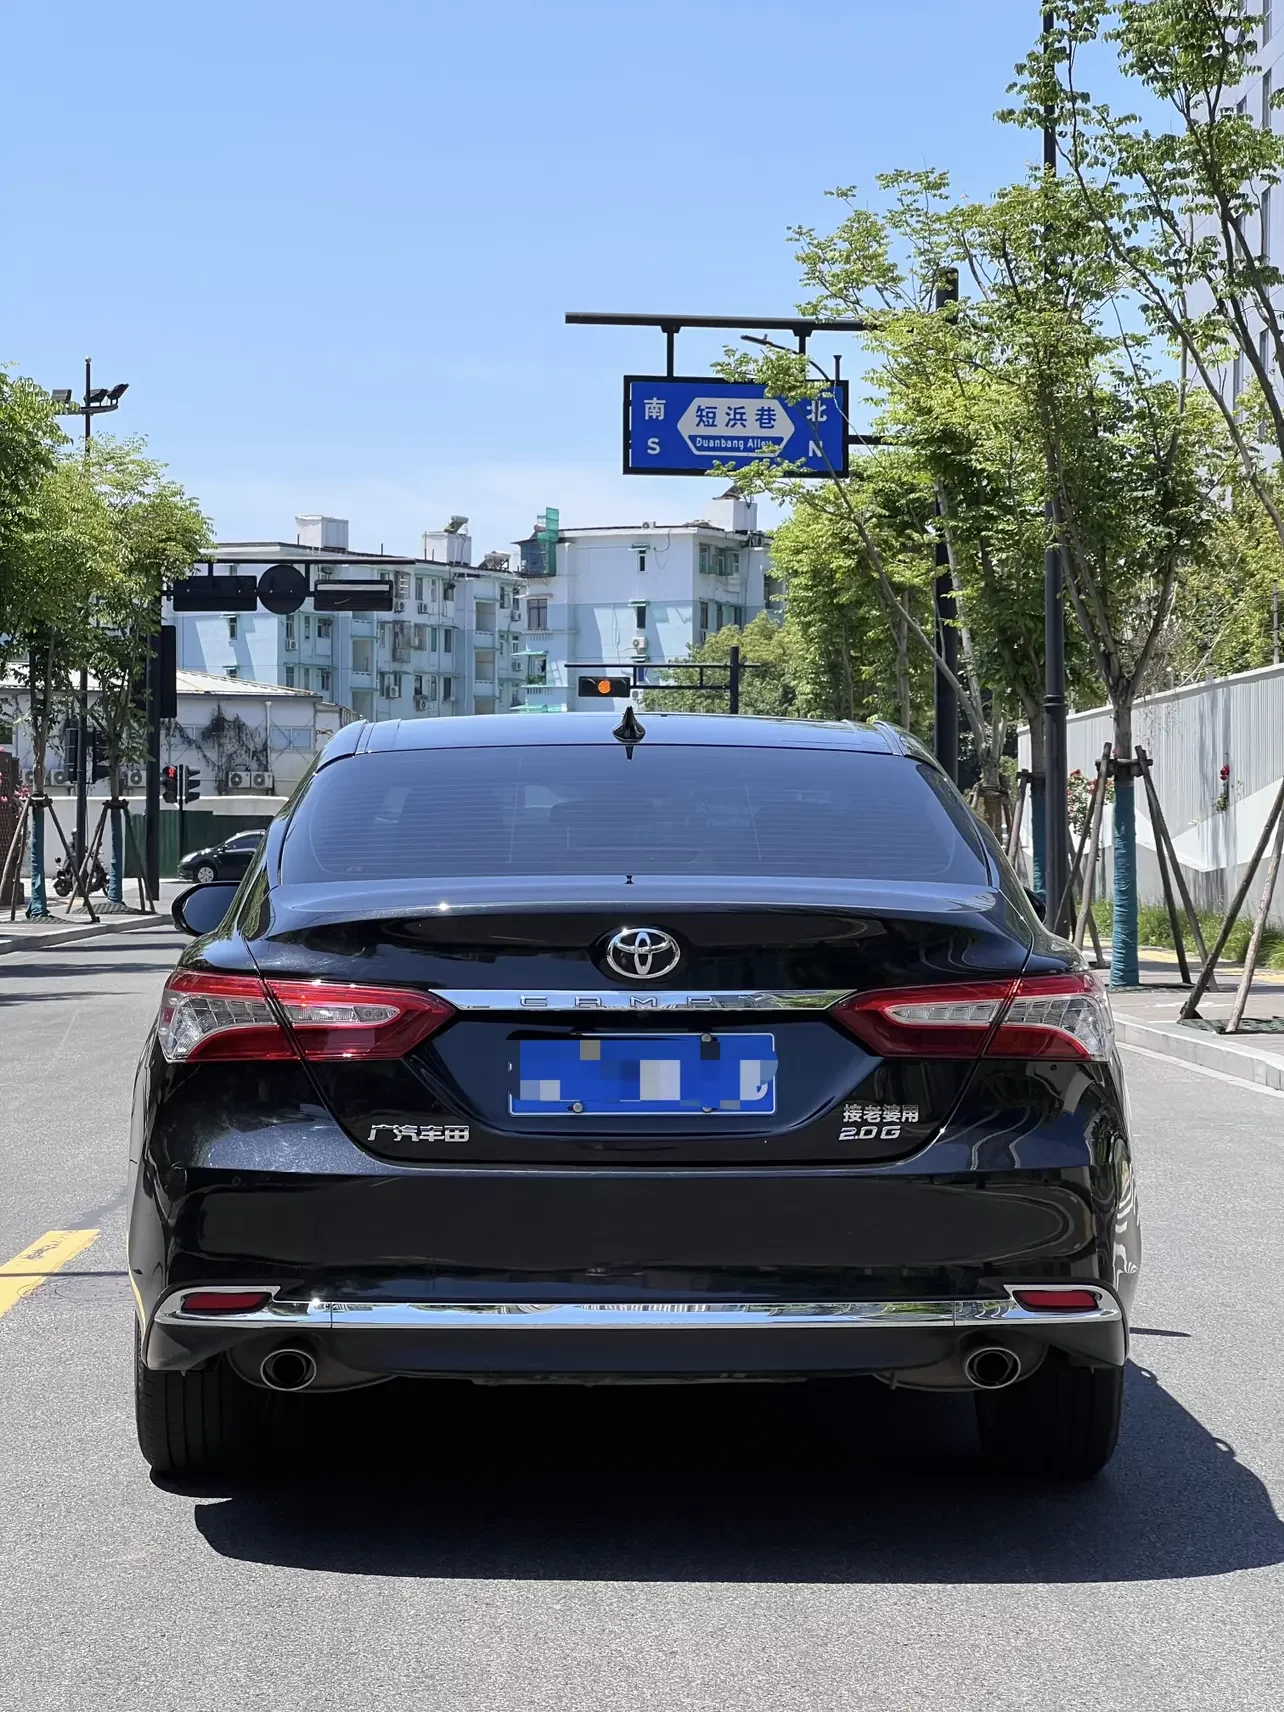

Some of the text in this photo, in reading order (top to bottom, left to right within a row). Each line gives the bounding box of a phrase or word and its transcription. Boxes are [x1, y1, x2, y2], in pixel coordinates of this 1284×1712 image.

[643, 396, 666, 421] 南
[695, 404, 777, 429] 短浜巷
[806, 399, 828, 422] 北
[646, 437, 661, 455] S
[696, 437, 744, 450] Duanbang
[808, 440, 823, 457] N
[843, 1103, 919, 1122] 接老婆用
